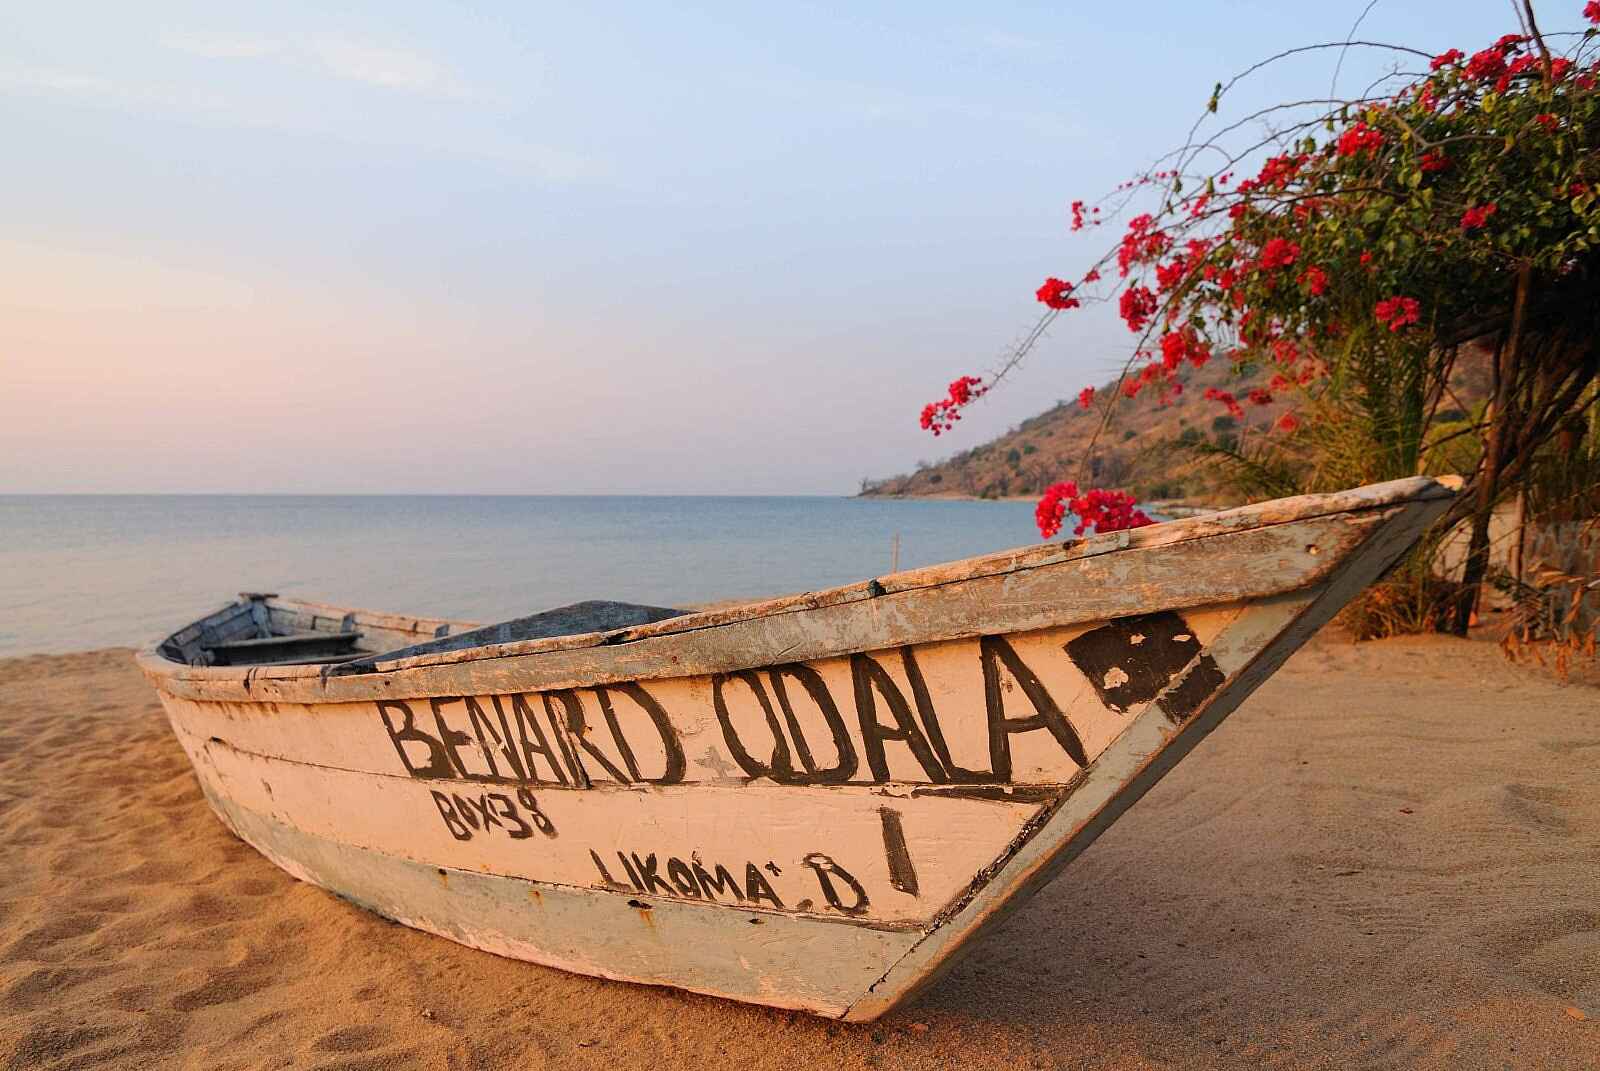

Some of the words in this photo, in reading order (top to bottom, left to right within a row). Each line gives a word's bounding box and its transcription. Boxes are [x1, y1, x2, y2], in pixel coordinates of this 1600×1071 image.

[377, 680, 687, 788] BENARD
[713, 634, 1090, 785] ODALA
[589, 848, 785, 909] LIKOMA
